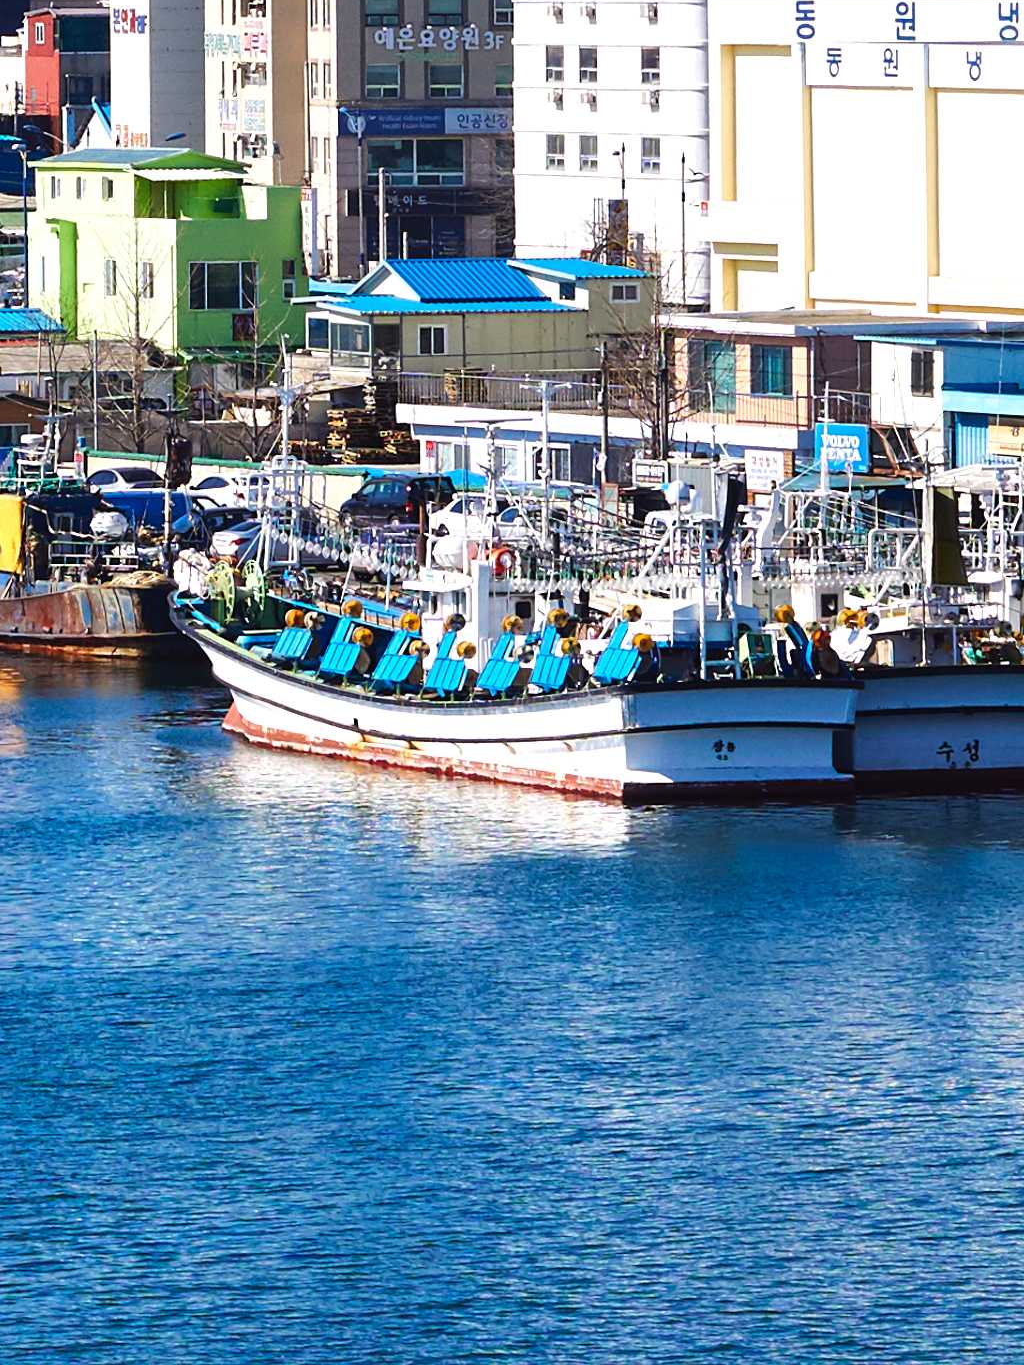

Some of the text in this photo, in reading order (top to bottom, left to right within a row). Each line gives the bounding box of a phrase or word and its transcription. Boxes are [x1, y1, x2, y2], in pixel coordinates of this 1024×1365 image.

[795, 0, 816, 40] 동
[895, 1, 916, 41] 원
[374, 26, 505, 51] 예은요양원 3F
[826, 47, 842, 78] 동
[883, 48, 899, 78] 원
[821, 434, 860, 448] VOLVO
[936, 739, 980, 762] 수성
